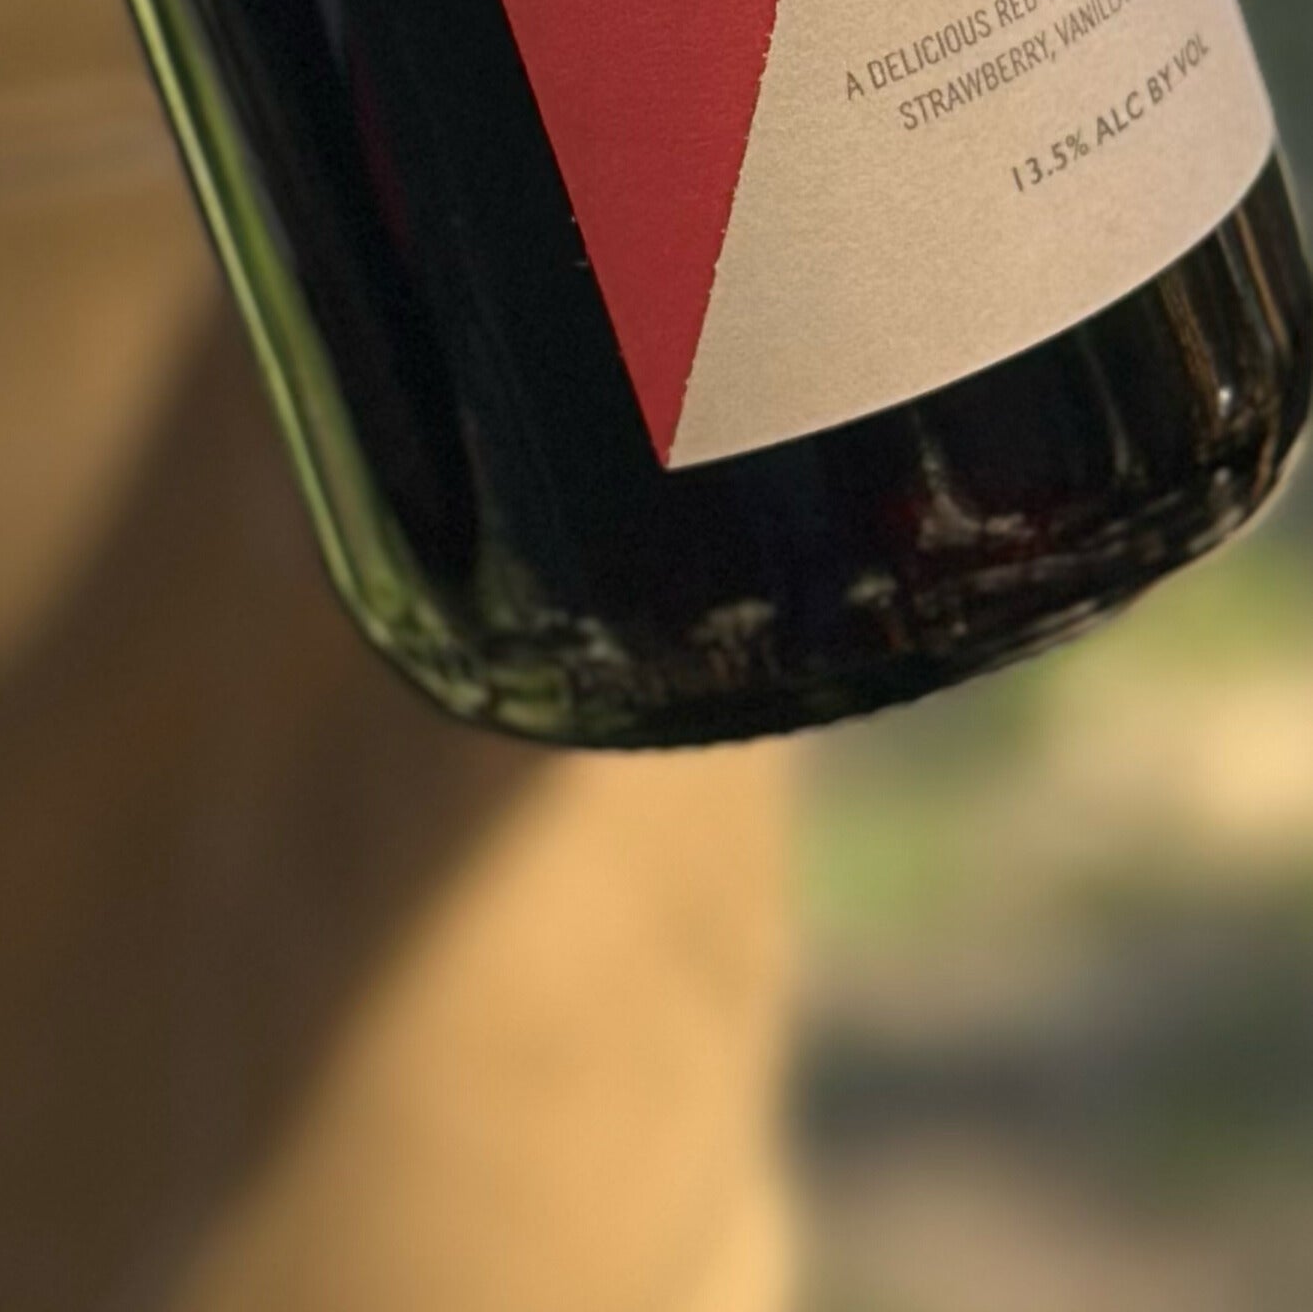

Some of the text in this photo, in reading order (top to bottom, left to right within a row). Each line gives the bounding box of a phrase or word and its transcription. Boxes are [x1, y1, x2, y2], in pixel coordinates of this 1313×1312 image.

[846, 70, 865, 102] A
[866, 8, 992, 91] DELICIOUS
[898, 30, 1058, 133] STRAWBERRY,
[1011, 30, 1211, 193] 13.5% ALC BY VOL
